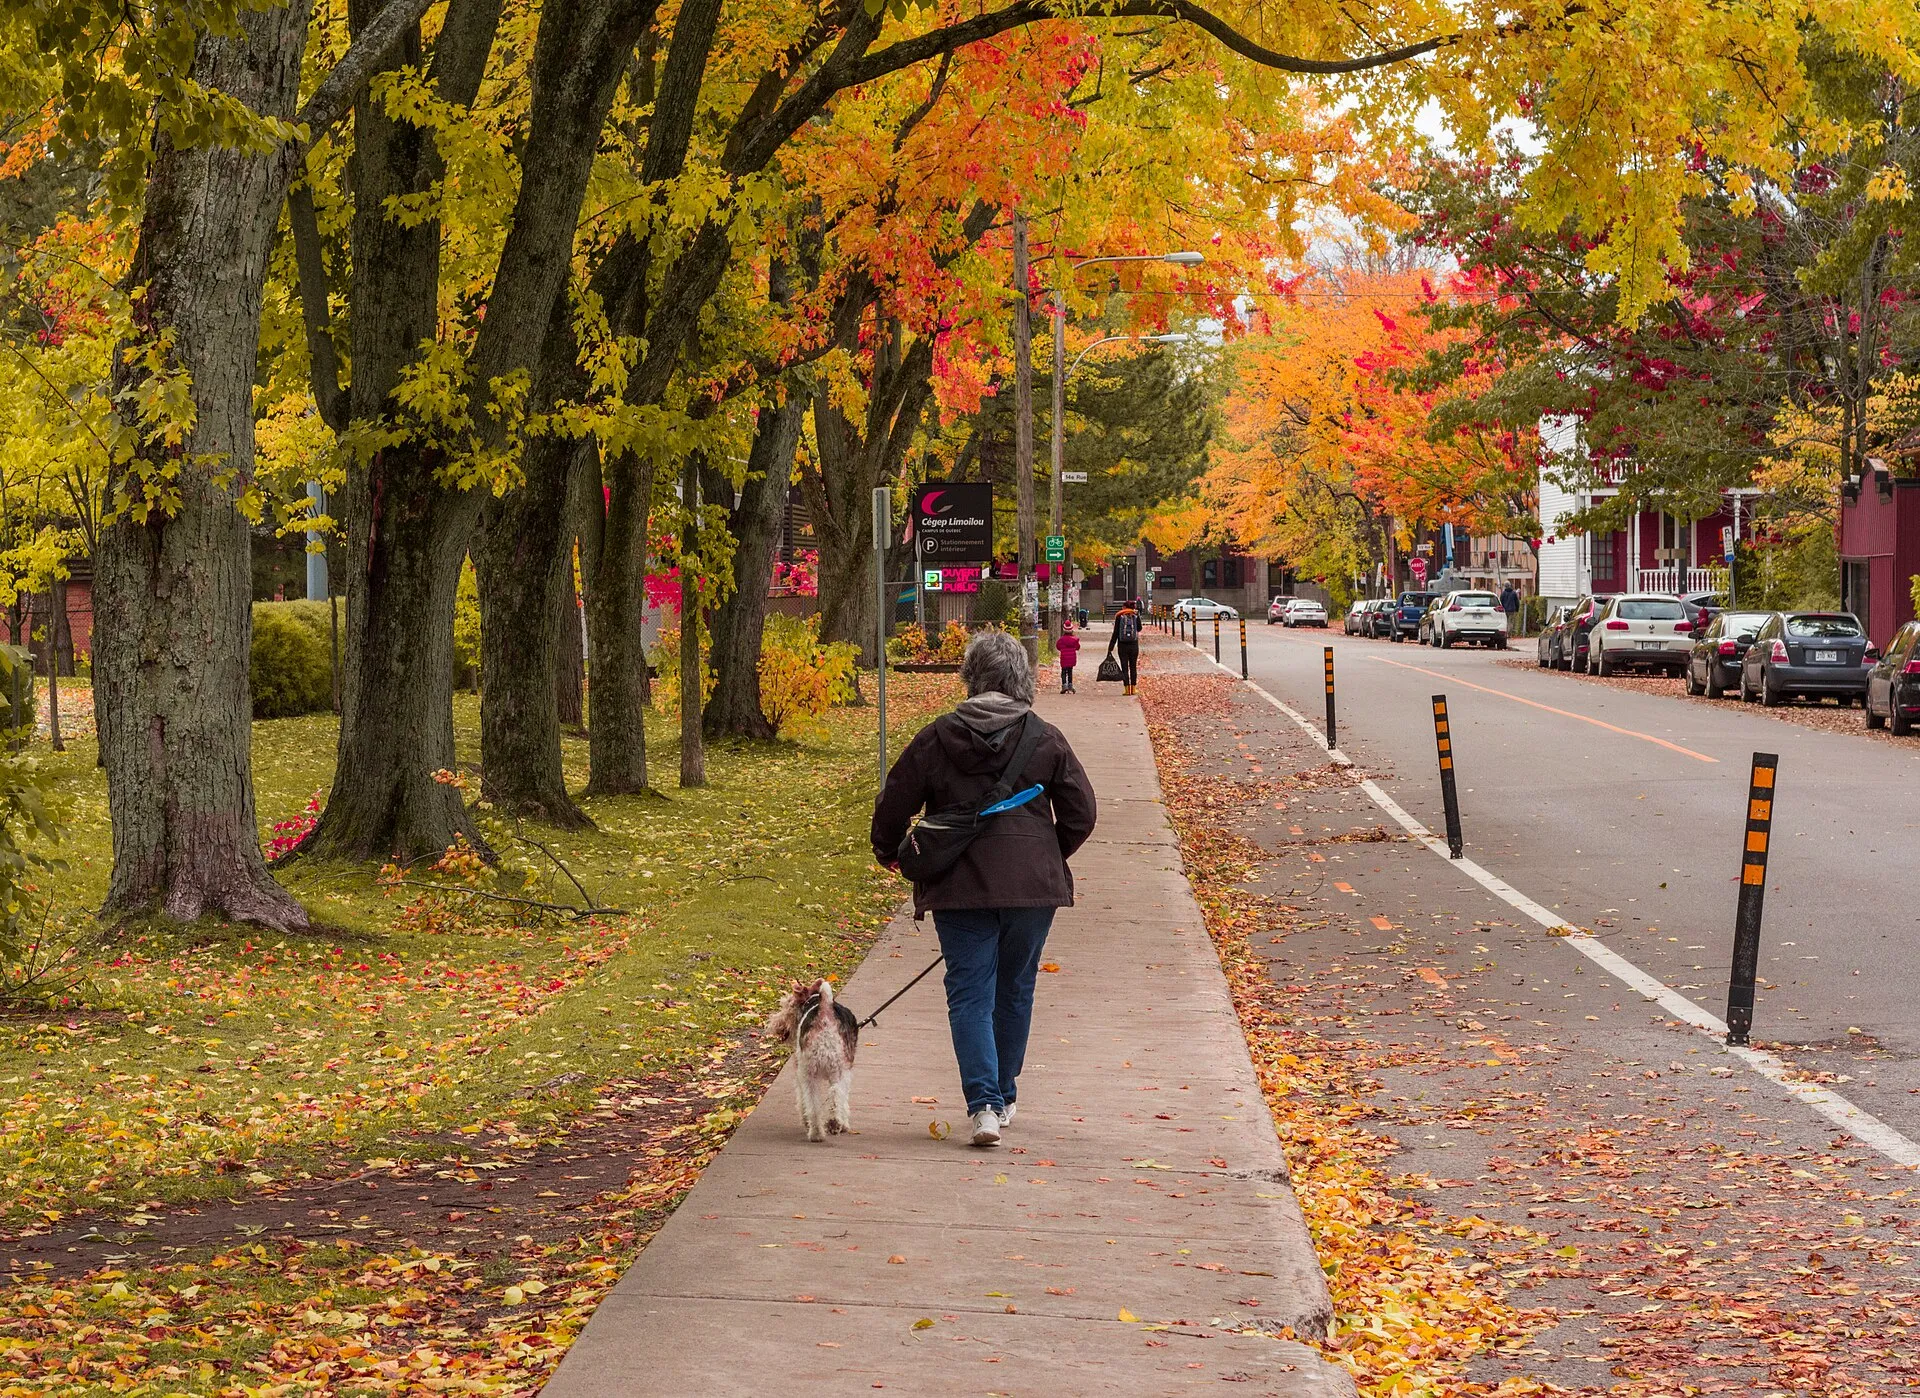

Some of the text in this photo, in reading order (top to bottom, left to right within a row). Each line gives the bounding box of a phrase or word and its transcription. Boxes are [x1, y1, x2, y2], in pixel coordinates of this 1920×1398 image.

[922, 517, 984, 527] Cégep Limoilou
[942, 568, 980, 577] OUVERT
[943, 582, 977, 592] PUBLIC
